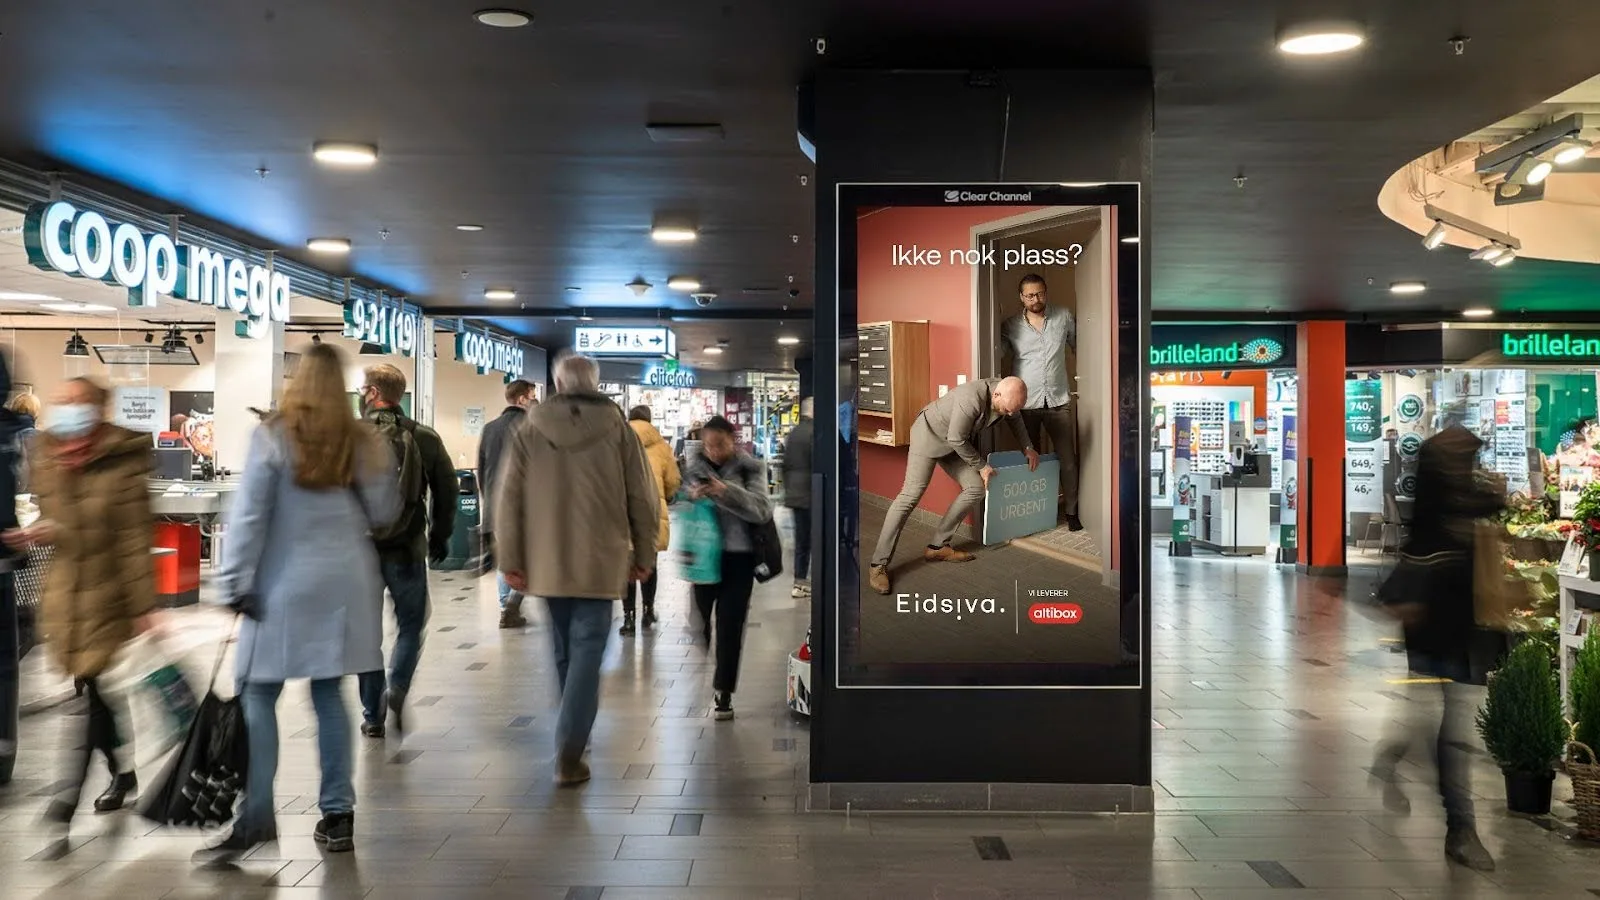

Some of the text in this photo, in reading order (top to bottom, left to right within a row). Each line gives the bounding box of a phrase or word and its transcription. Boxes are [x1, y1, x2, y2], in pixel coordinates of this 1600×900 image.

[960, 191, 1032, 202] Clear Channel
[892, 243, 1083, 270] Ikke nok plass?
[40, 201, 290, 340] coop mega
[353, 299, 416, 359] 9-21 (19)
[462, 332, 523, 382] coop mega
[1150, 342, 1238, 364] brilleland
[650, 369, 695, 386] elitefoto
[1351, 459, 1375, 471] 649,-
[1003, 477, 1047, 499] 500 GB
[1354, 485, 1372, 495] 46,-
[1000, 498, 1047, 521] URGENT
[1028, 589, 1069, 597] VI LEVERER
[1033, 606, 1078, 619] altibox
